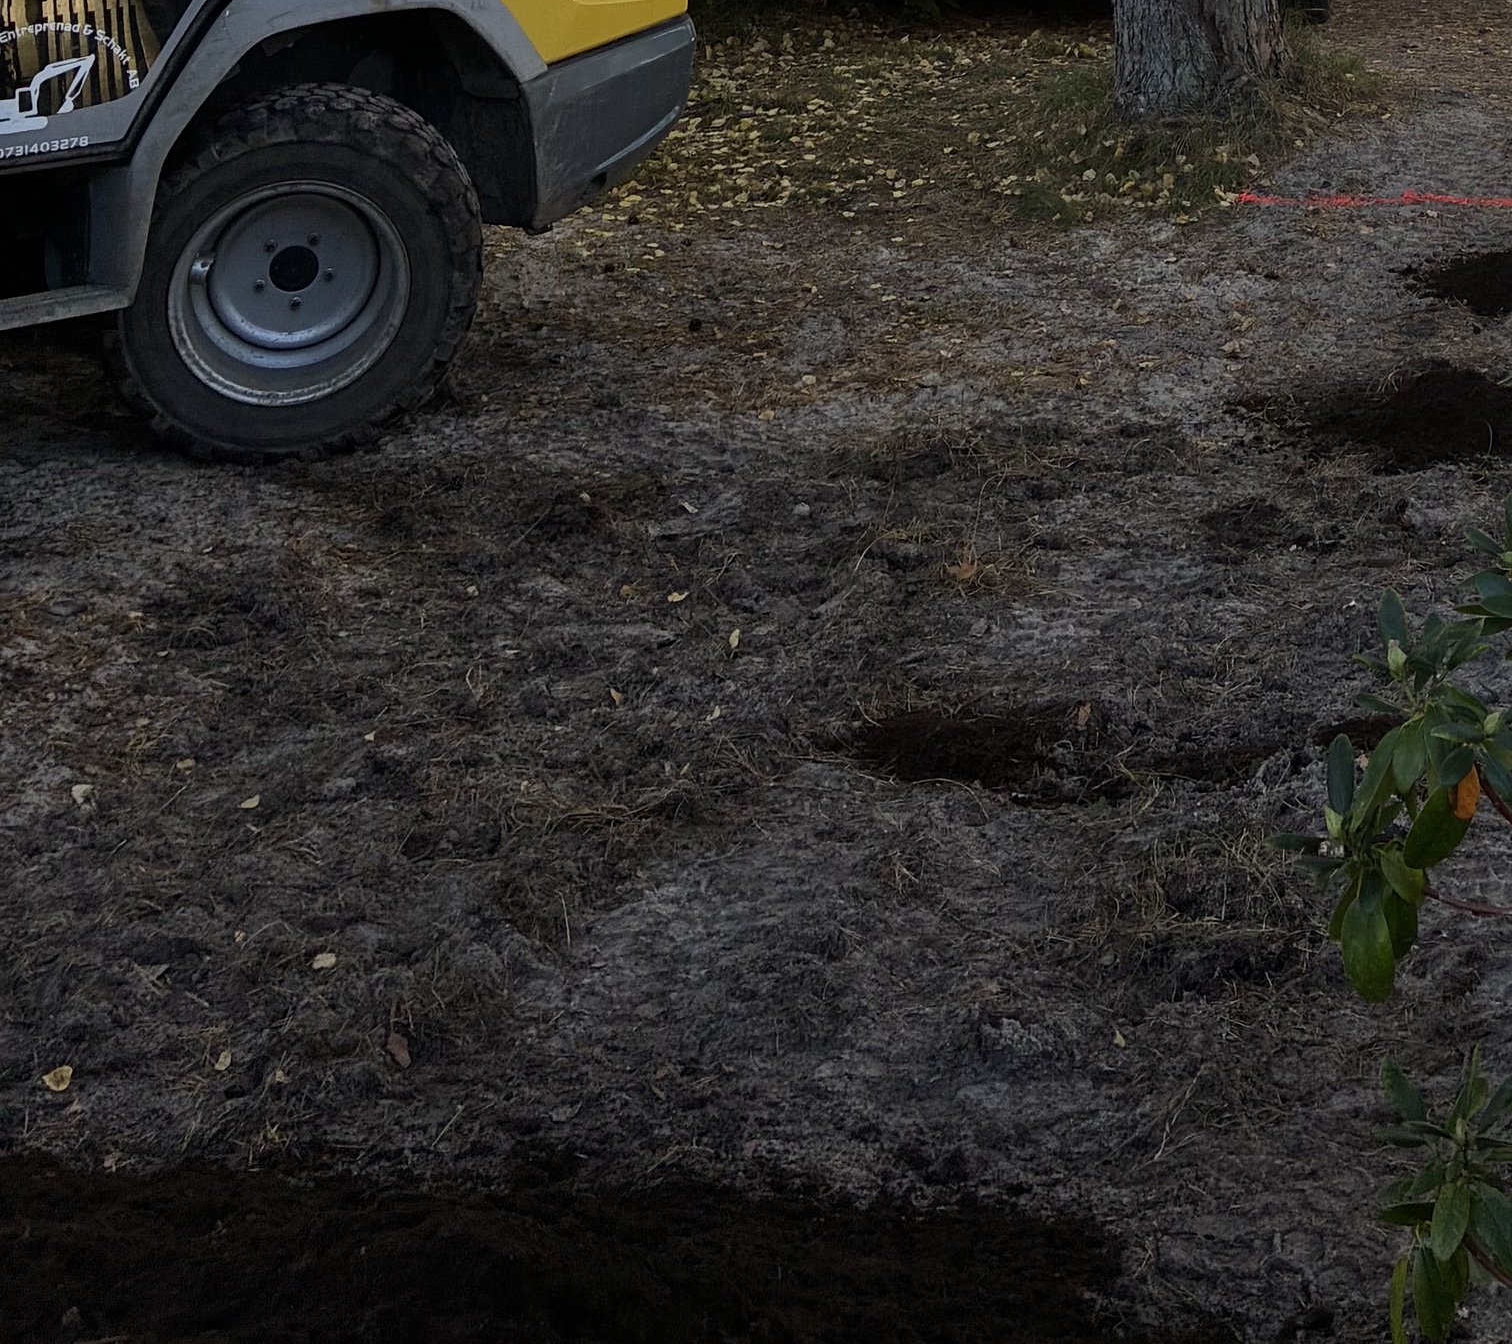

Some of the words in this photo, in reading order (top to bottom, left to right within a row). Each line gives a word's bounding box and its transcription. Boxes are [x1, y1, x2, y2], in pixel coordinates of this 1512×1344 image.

[0, 22, 81, 43] Entreprenad
[82, 24, 94, 36] &
[94, 29, 131, 66] Schakt
[126, 69, 140, 89] AB
